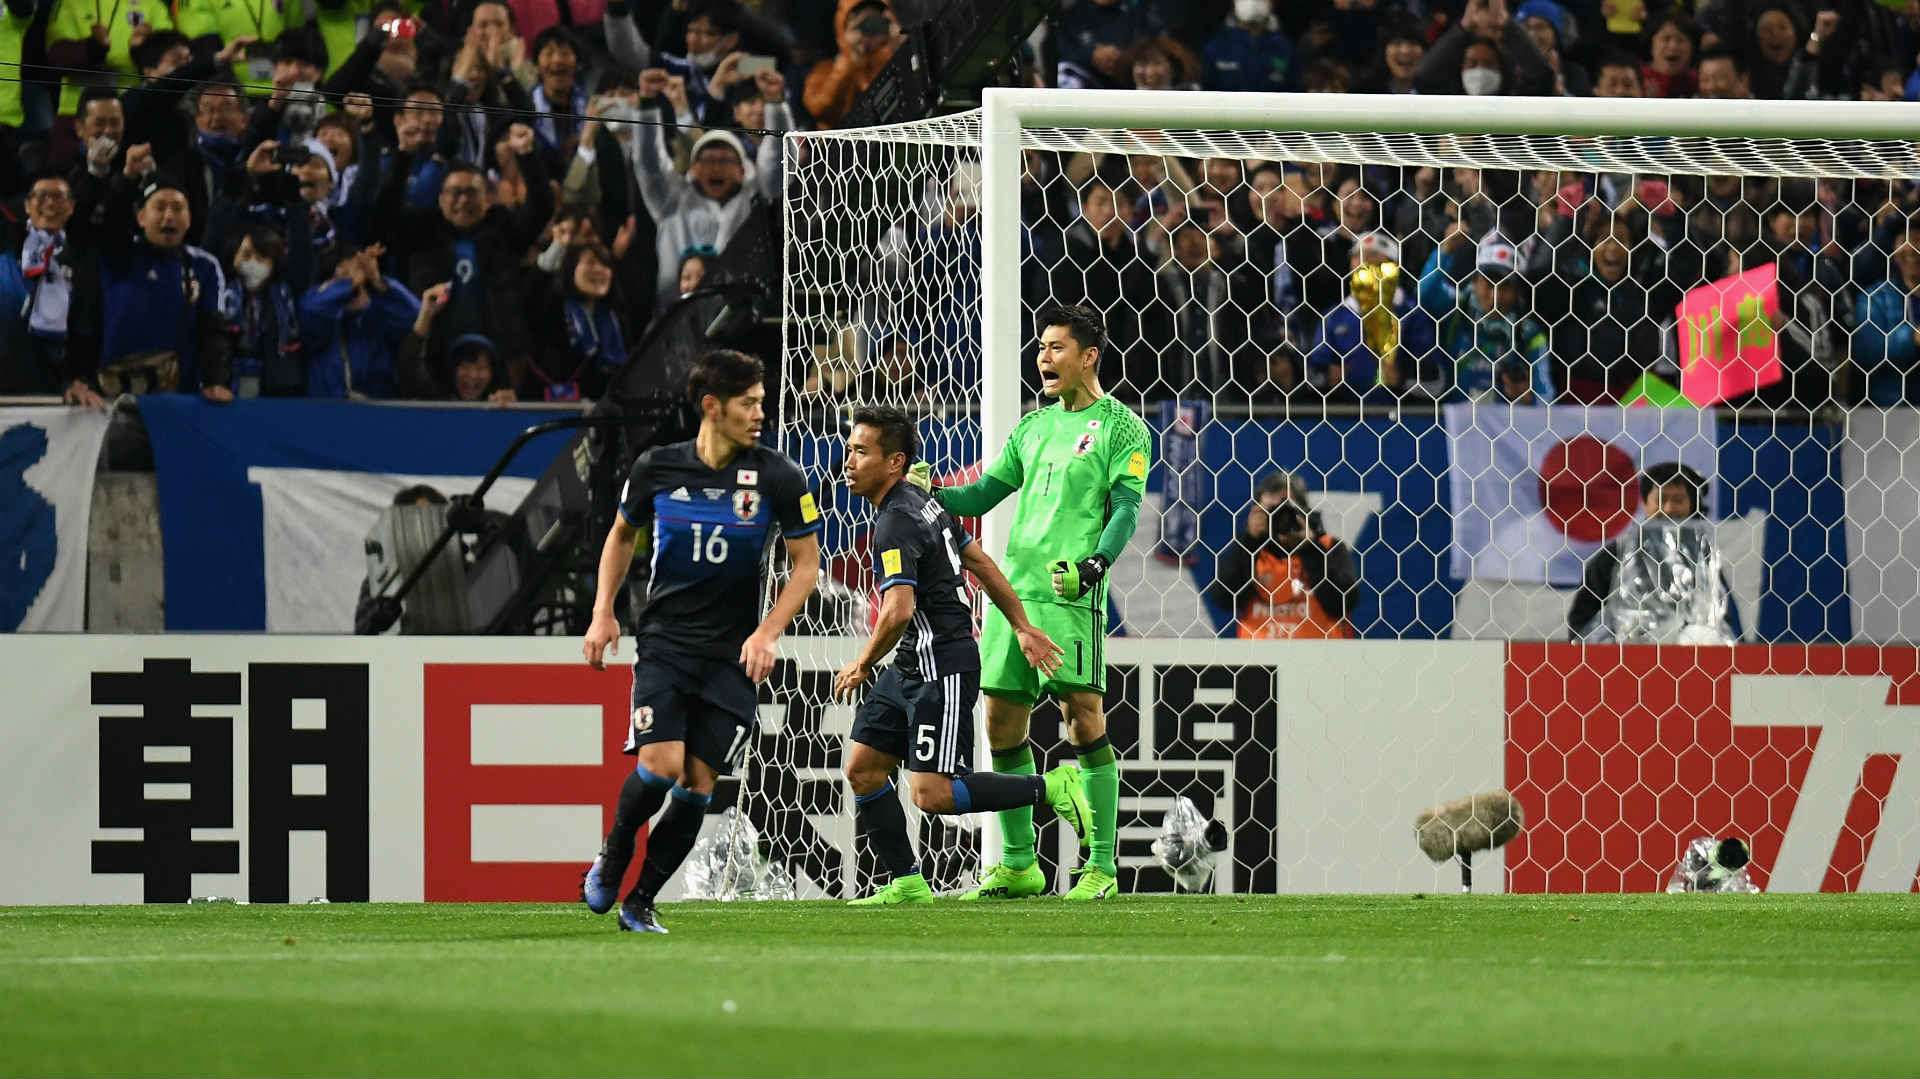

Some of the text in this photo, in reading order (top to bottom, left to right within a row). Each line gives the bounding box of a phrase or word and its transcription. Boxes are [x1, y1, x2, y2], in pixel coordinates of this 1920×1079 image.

[690, 522, 729, 564] 16
[1073, 640, 1083, 677] 1
[915, 724, 936, 761] 5
